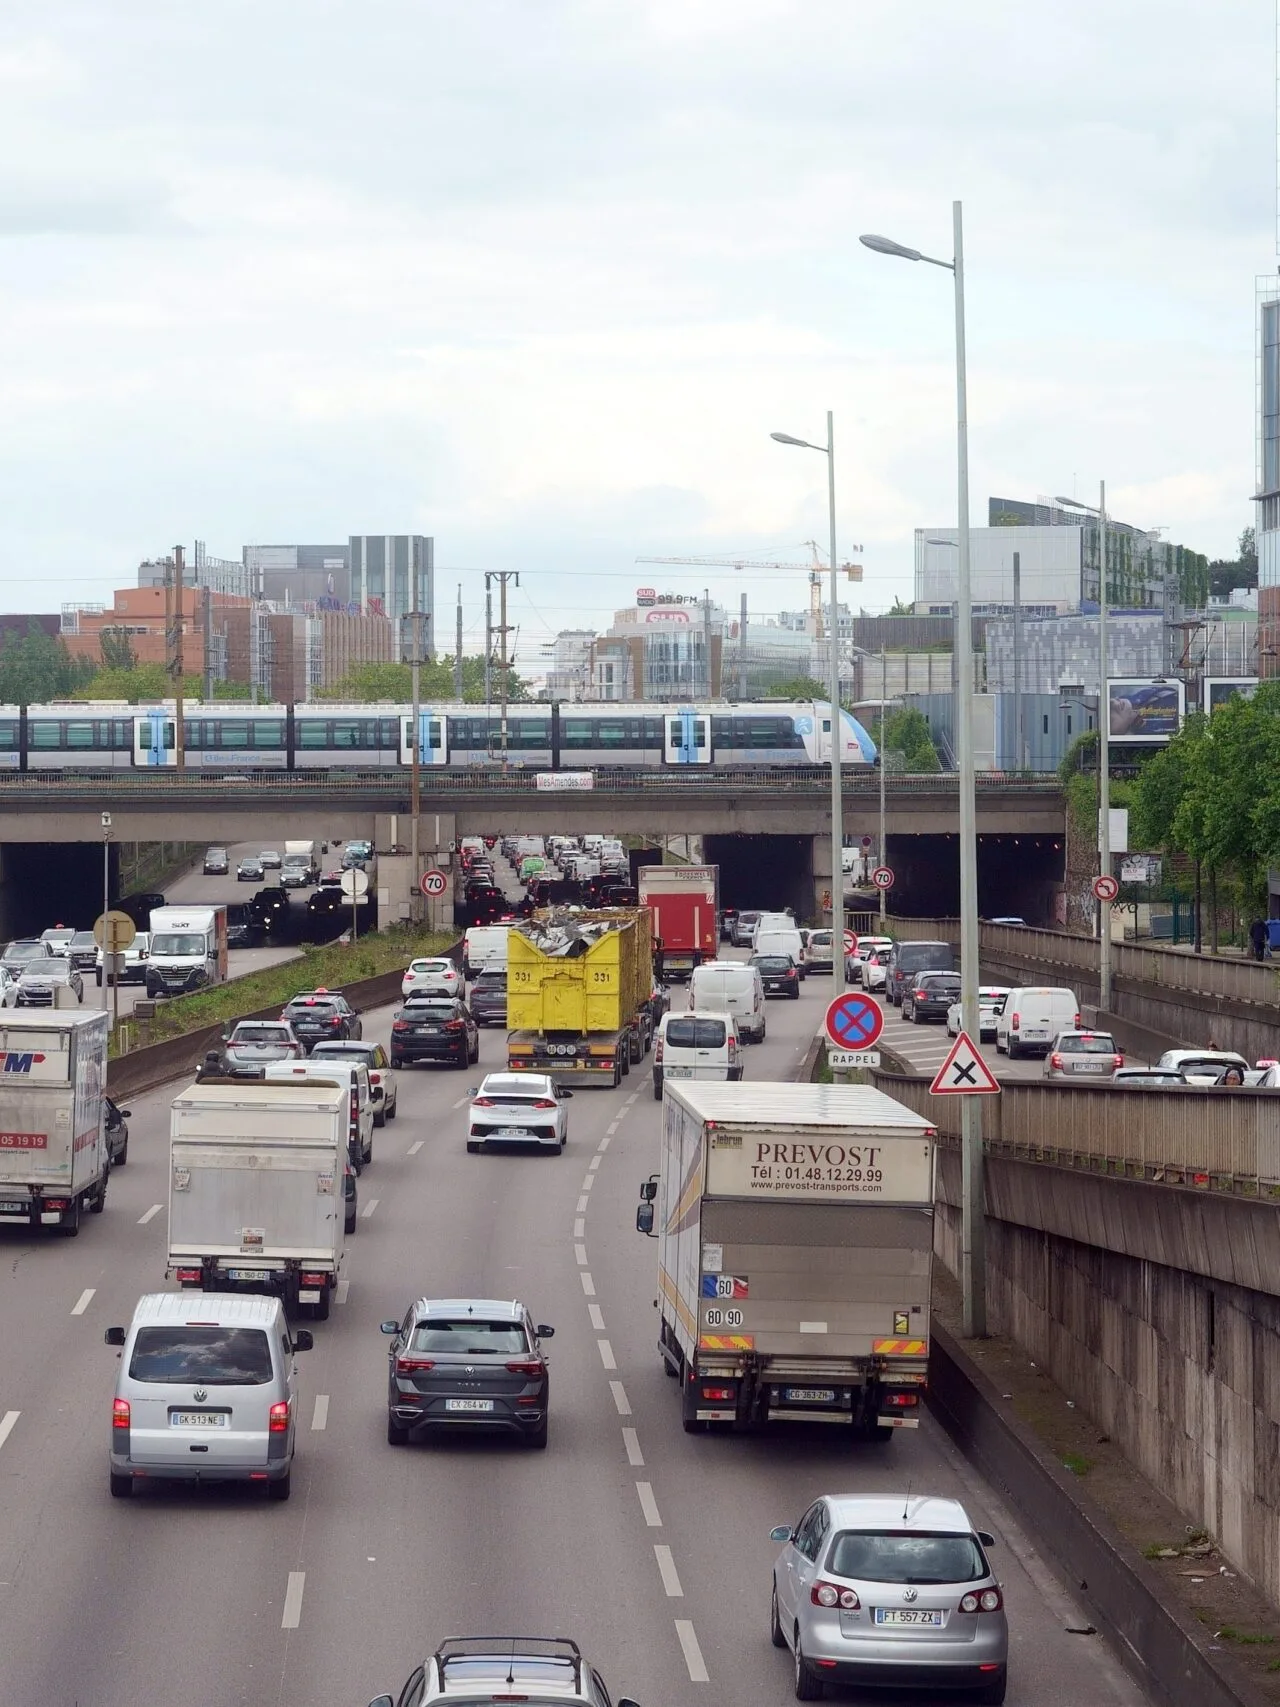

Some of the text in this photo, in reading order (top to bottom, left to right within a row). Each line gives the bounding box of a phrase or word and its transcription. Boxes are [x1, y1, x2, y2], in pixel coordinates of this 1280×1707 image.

[538, 776, 592, 788] MesAmendes.com
[427, 878, 442, 889] 70
[877, 873, 889, 883] 70
[515, 972, 531, 982] 331
[594, 973, 610, 982] 331
[833, 1055, 876, 1064] RAPPEL
[1, 1136, 14, 1145] 05
[17, 1137, 28, 1145] 19
[32, 1137, 43, 1146] 19
[756, 1142, 881, 1167] PREVOST
[751, 1166, 772, 1179] Tél
[785, 1167, 882, 1182] 01.48.12.29.99
[751, 1180, 882, 1192] www.prevost-transports.com
[720, 1280, 732, 1295] 60
[708, 1310, 741, 1325] 80 90
